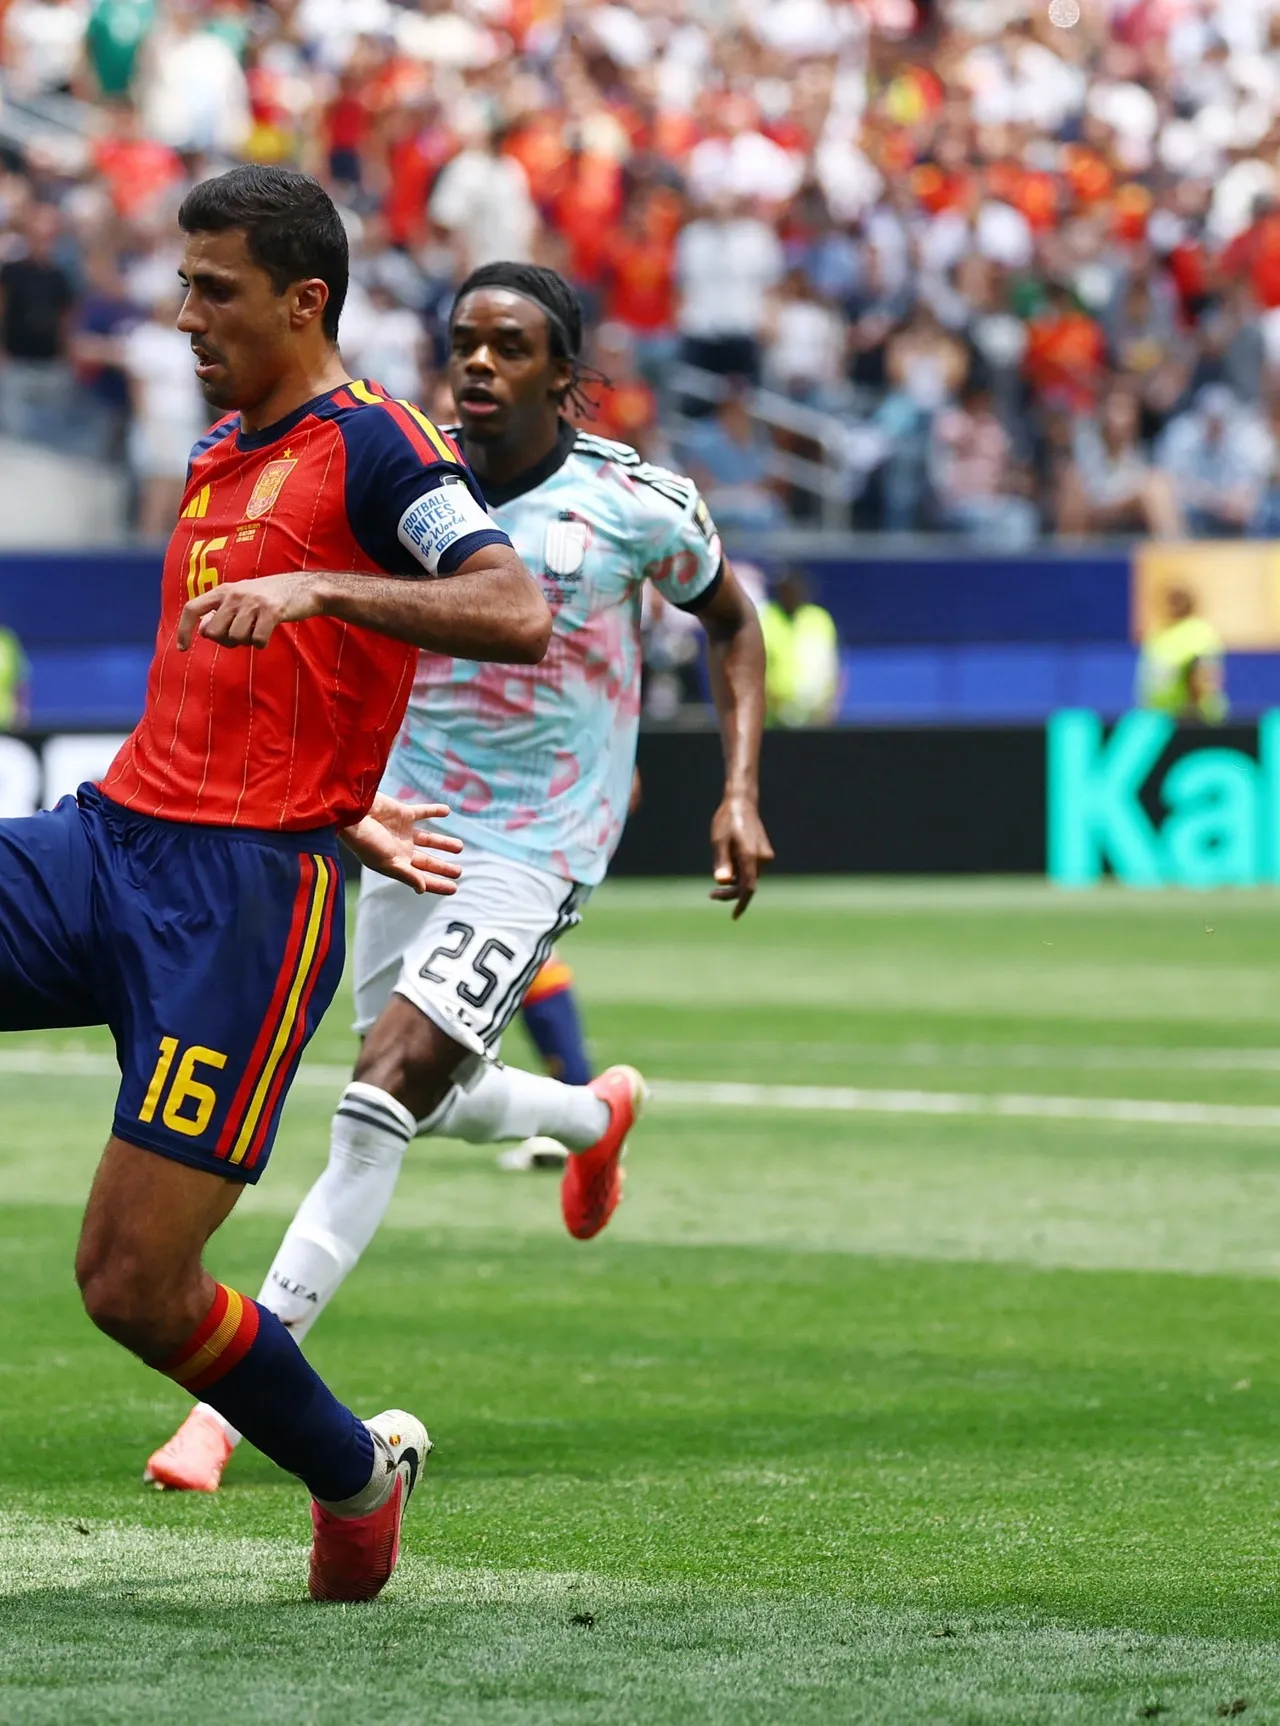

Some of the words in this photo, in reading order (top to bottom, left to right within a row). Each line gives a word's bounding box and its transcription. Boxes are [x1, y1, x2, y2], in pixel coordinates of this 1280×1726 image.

[402, 493, 450, 535] FOOTBALL
[410, 503, 456, 546] UNITES
[420, 539, 434, 558] the
[429, 513, 468, 540] World
[187, 536, 229, 601] 16
[419, 921, 515, 1008] 25
[138, 1036, 228, 1137] 16
